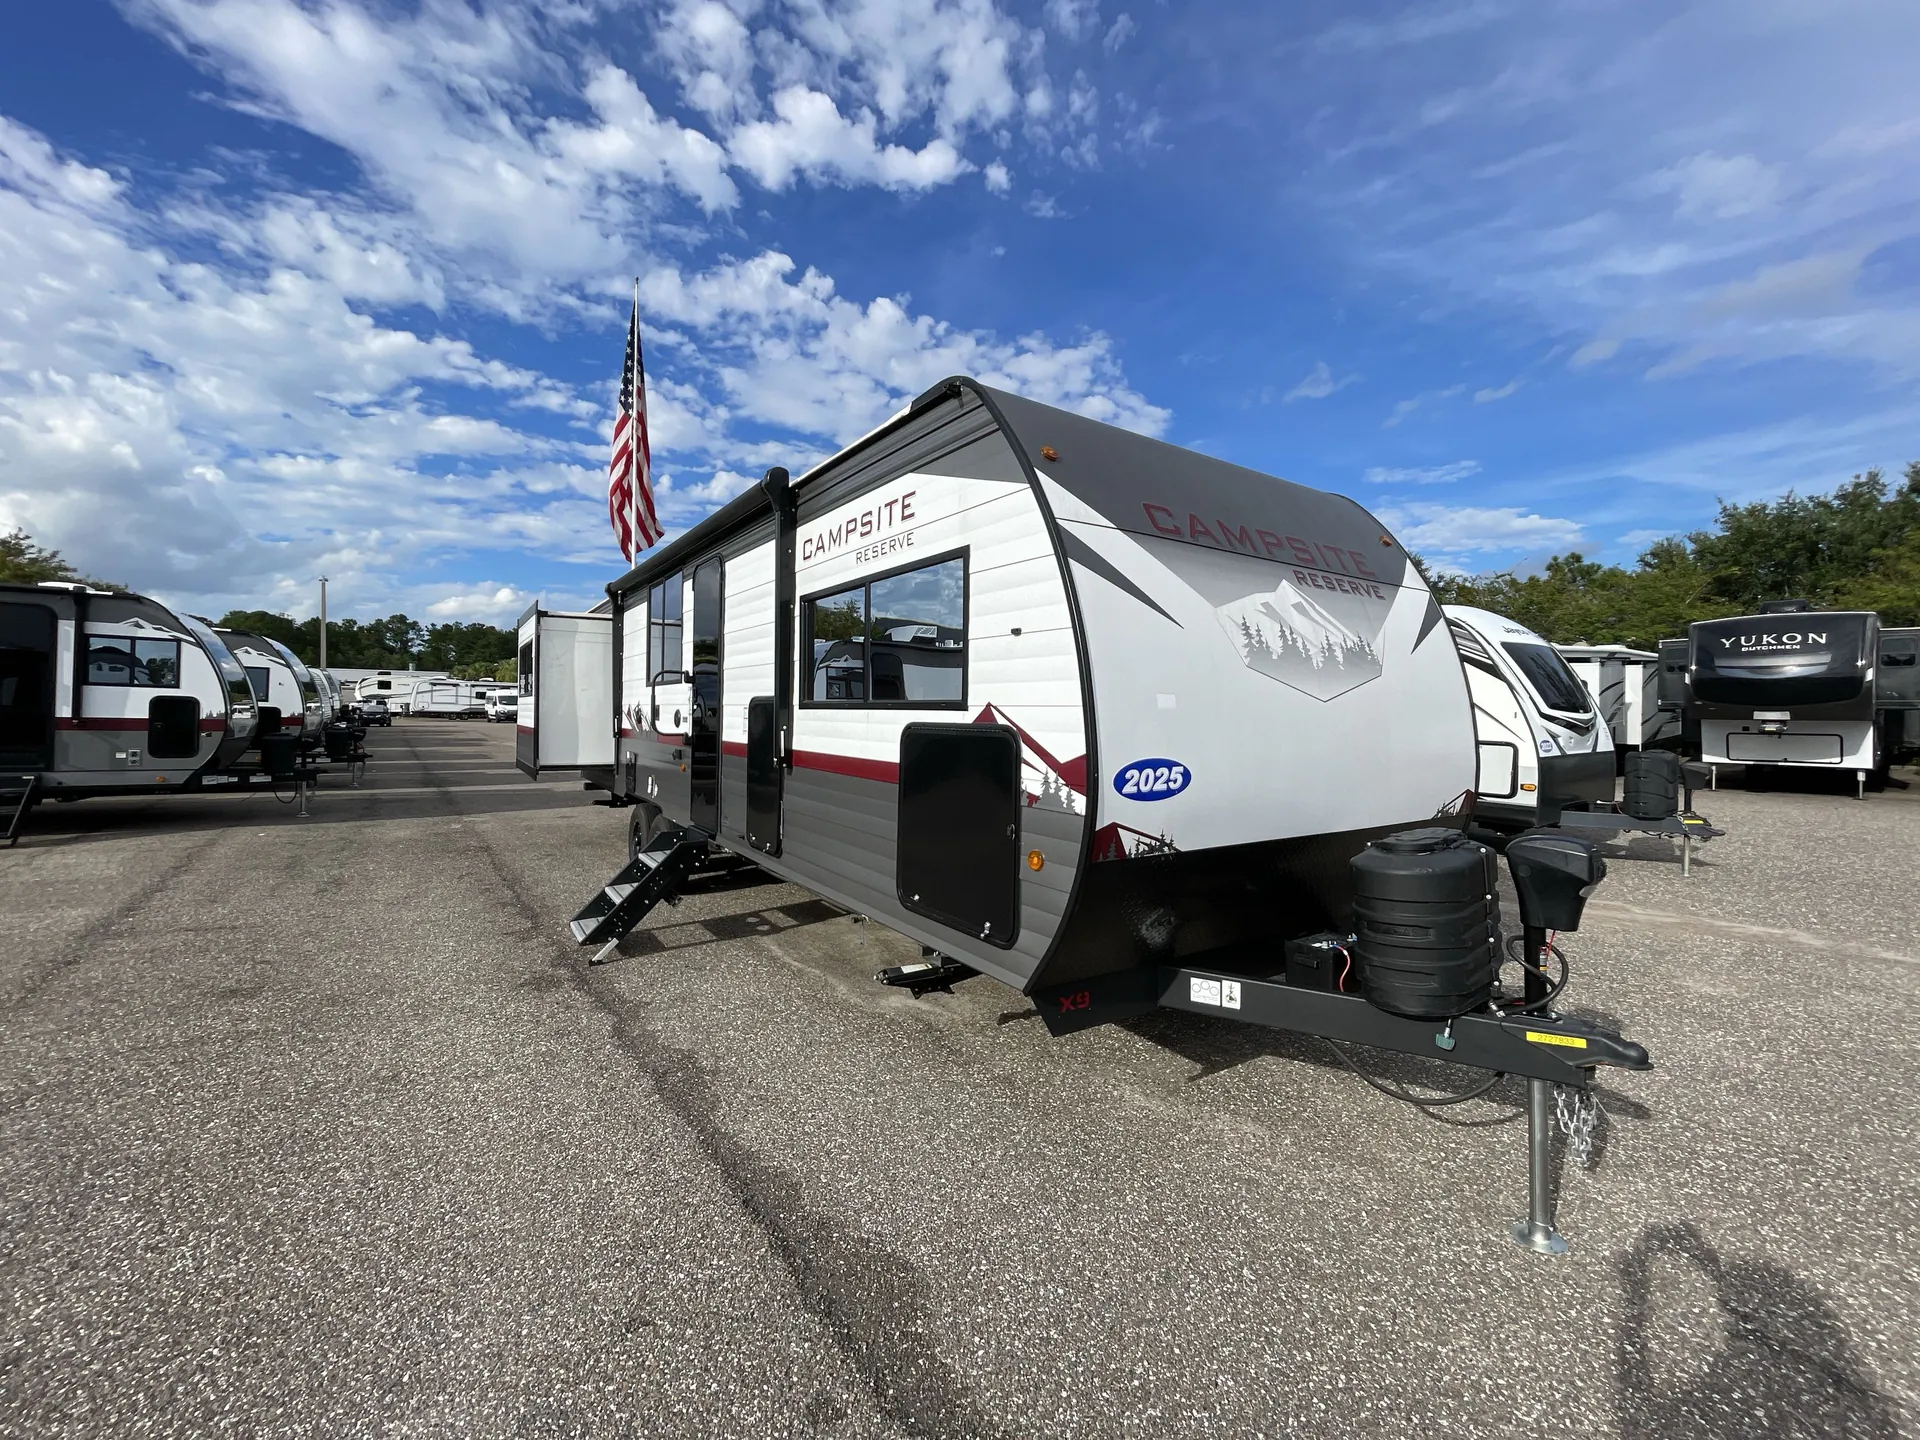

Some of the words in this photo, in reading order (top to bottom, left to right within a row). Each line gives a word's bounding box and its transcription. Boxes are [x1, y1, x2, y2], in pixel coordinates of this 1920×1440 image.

[803, 491, 916, 561] CAMPSITE
[1141, 502, 1378, 578] CAMPSITE
[856, 532, 914, 565] RESERVE
[1292, 569, 1386, 601] RESERVE
[1720, 633, 1827, 648] YUKON
[1741, 644, 1800, 652] DUTCHMEN
[1121, 765, 1184, 794] 2025
[1059, 991, 1091, 1013] X9
